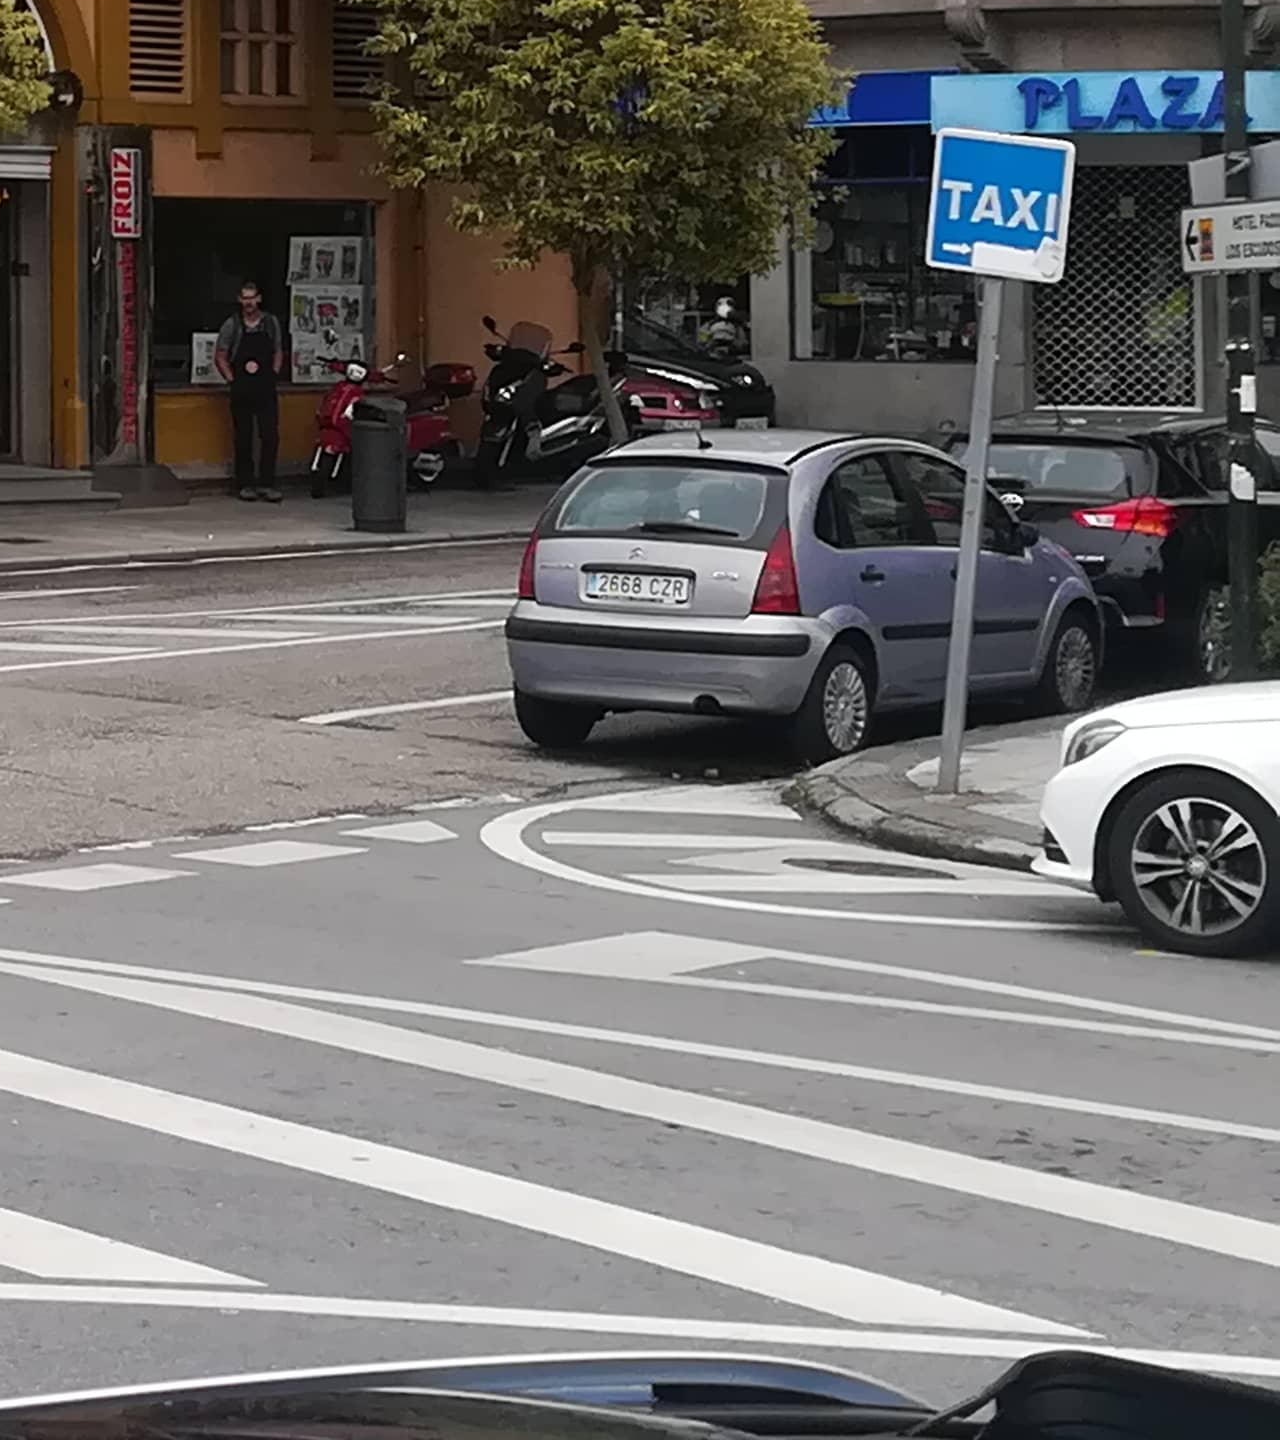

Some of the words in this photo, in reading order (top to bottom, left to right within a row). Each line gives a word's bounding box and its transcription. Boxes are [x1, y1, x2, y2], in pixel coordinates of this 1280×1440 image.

[1017, 76, 1253, 132] PLAZA
[113, 152, 133, 235] FROIZ
[942, 179, 1059, 233] TAXI
[598, 574, 642, 594] 2668
[649, 577, 684, 598] CZR
